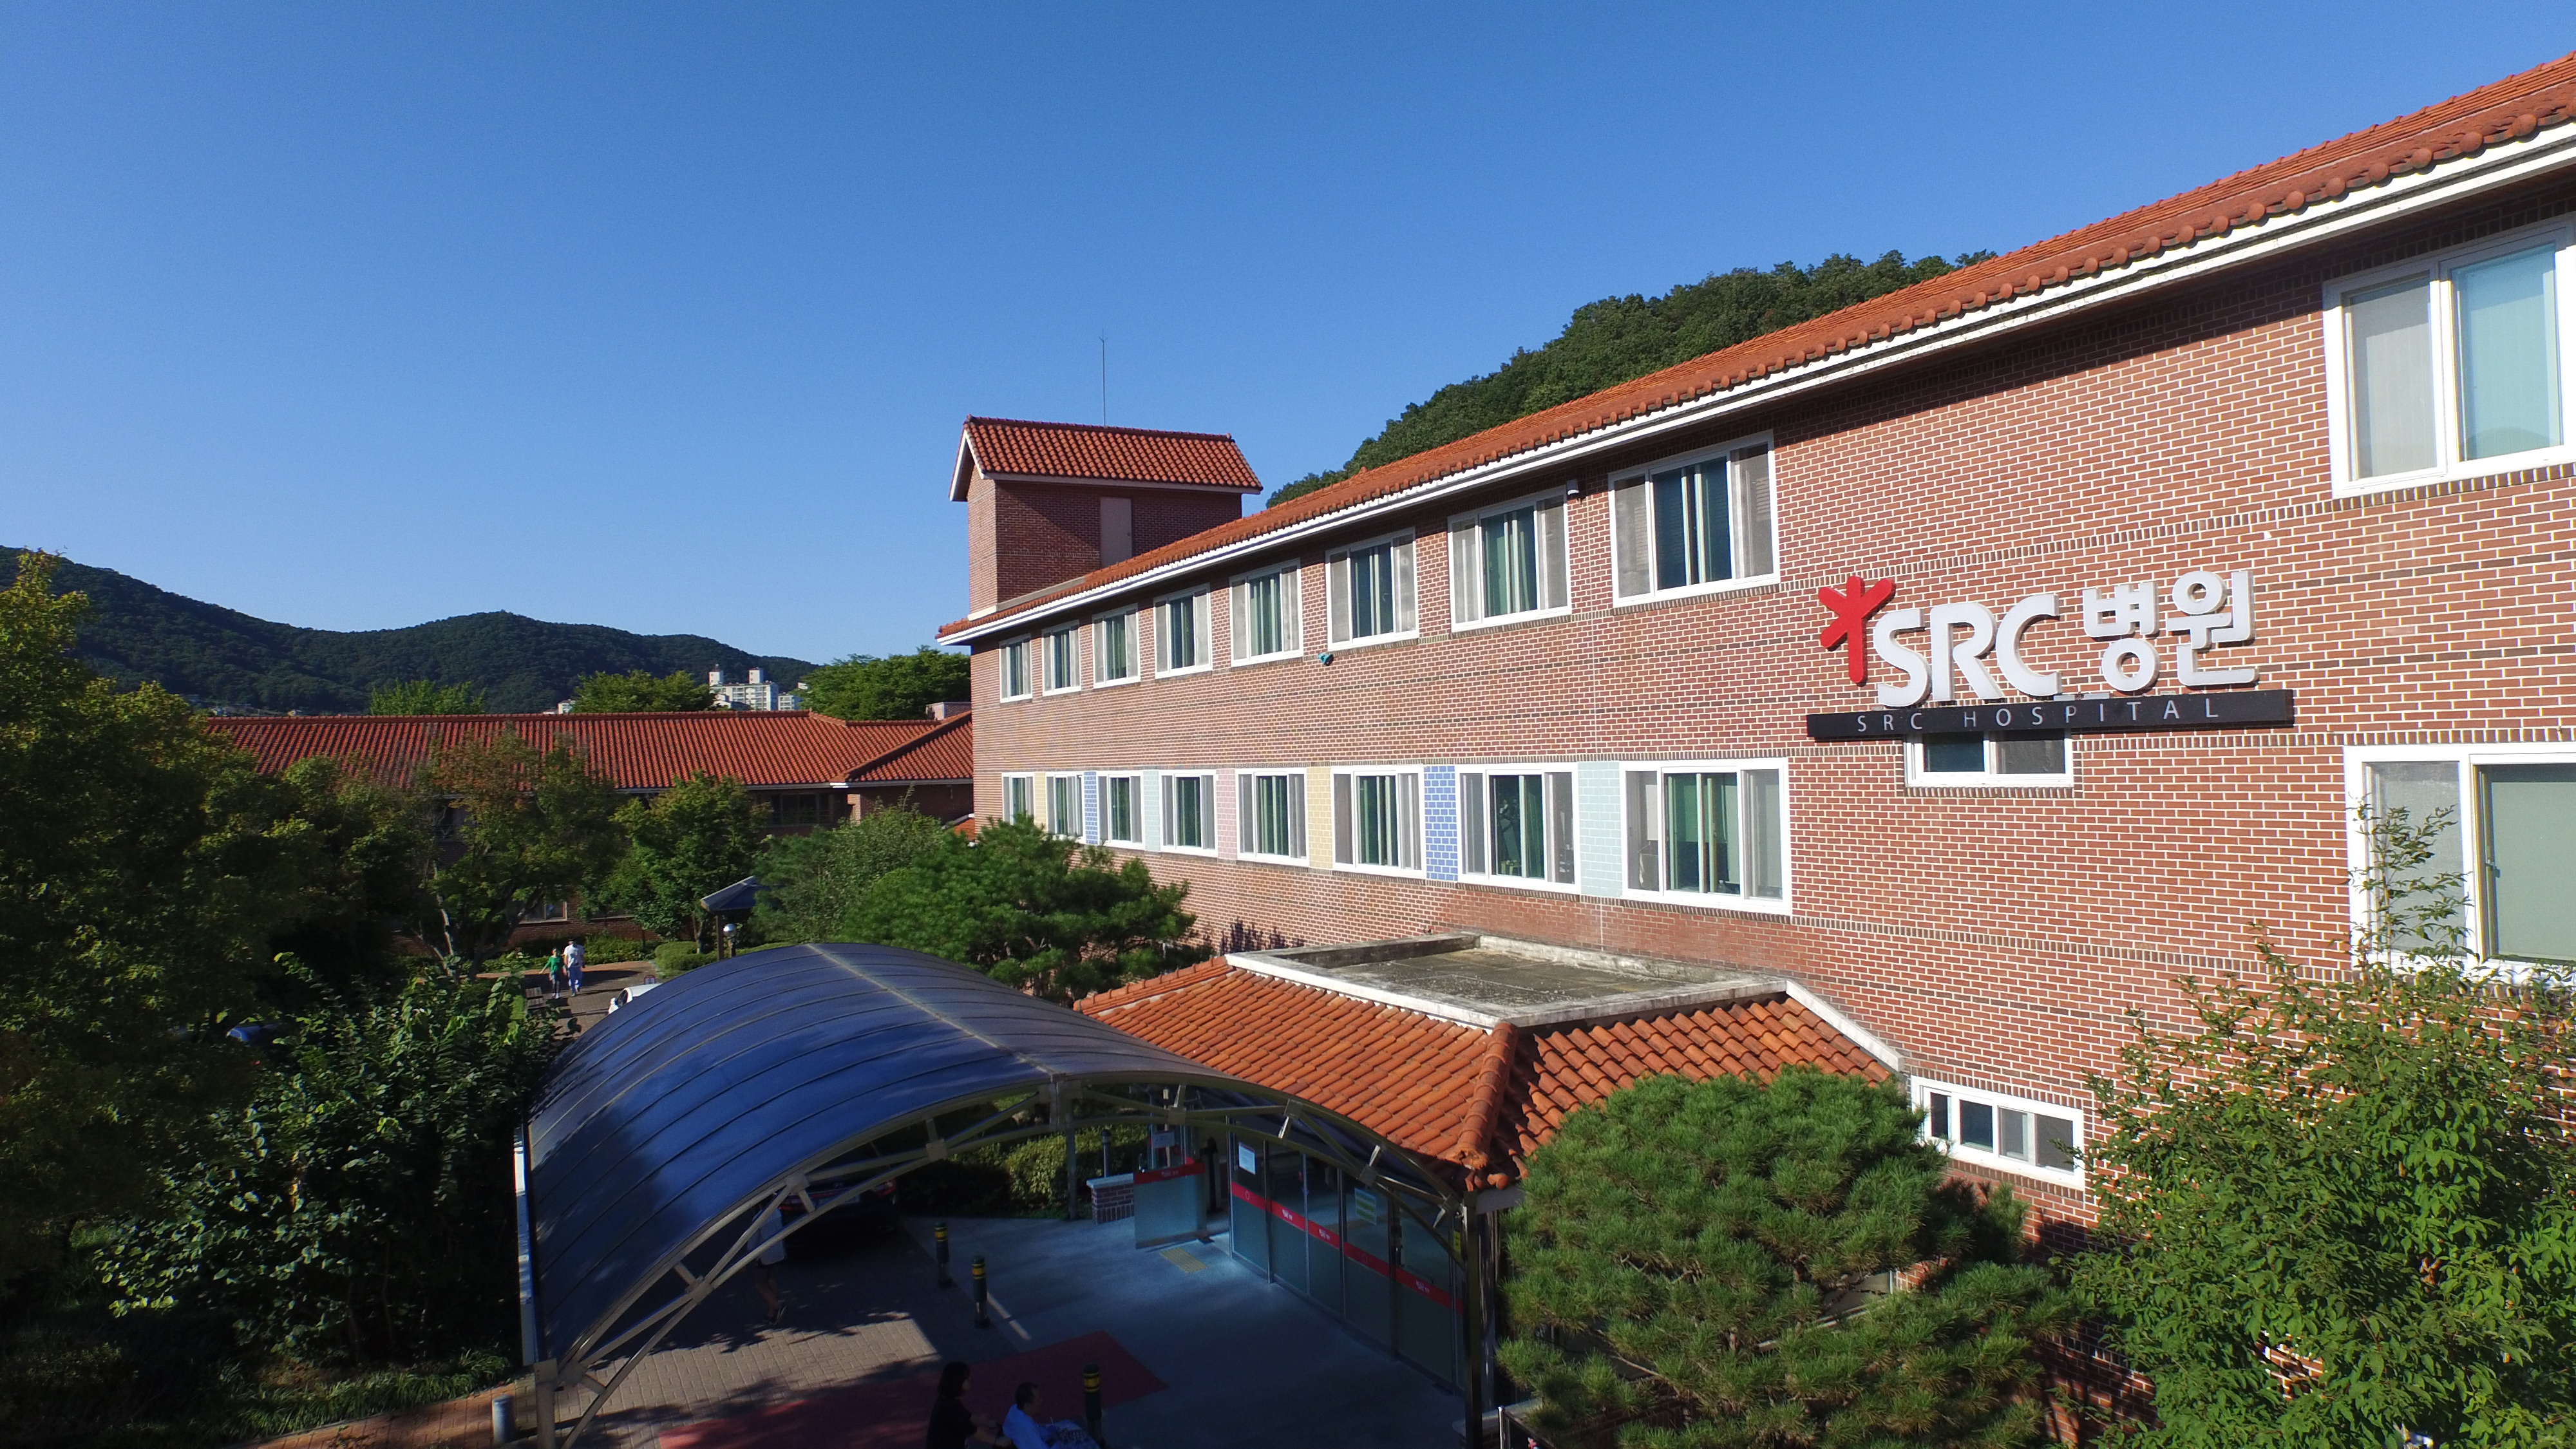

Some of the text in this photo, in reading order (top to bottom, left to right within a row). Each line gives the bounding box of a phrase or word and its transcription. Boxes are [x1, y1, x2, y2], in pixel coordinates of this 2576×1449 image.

[1873, 570, 2259, 708] SRC 병원
[1857, 697, 2218, 732] SRC HOSPITAL
